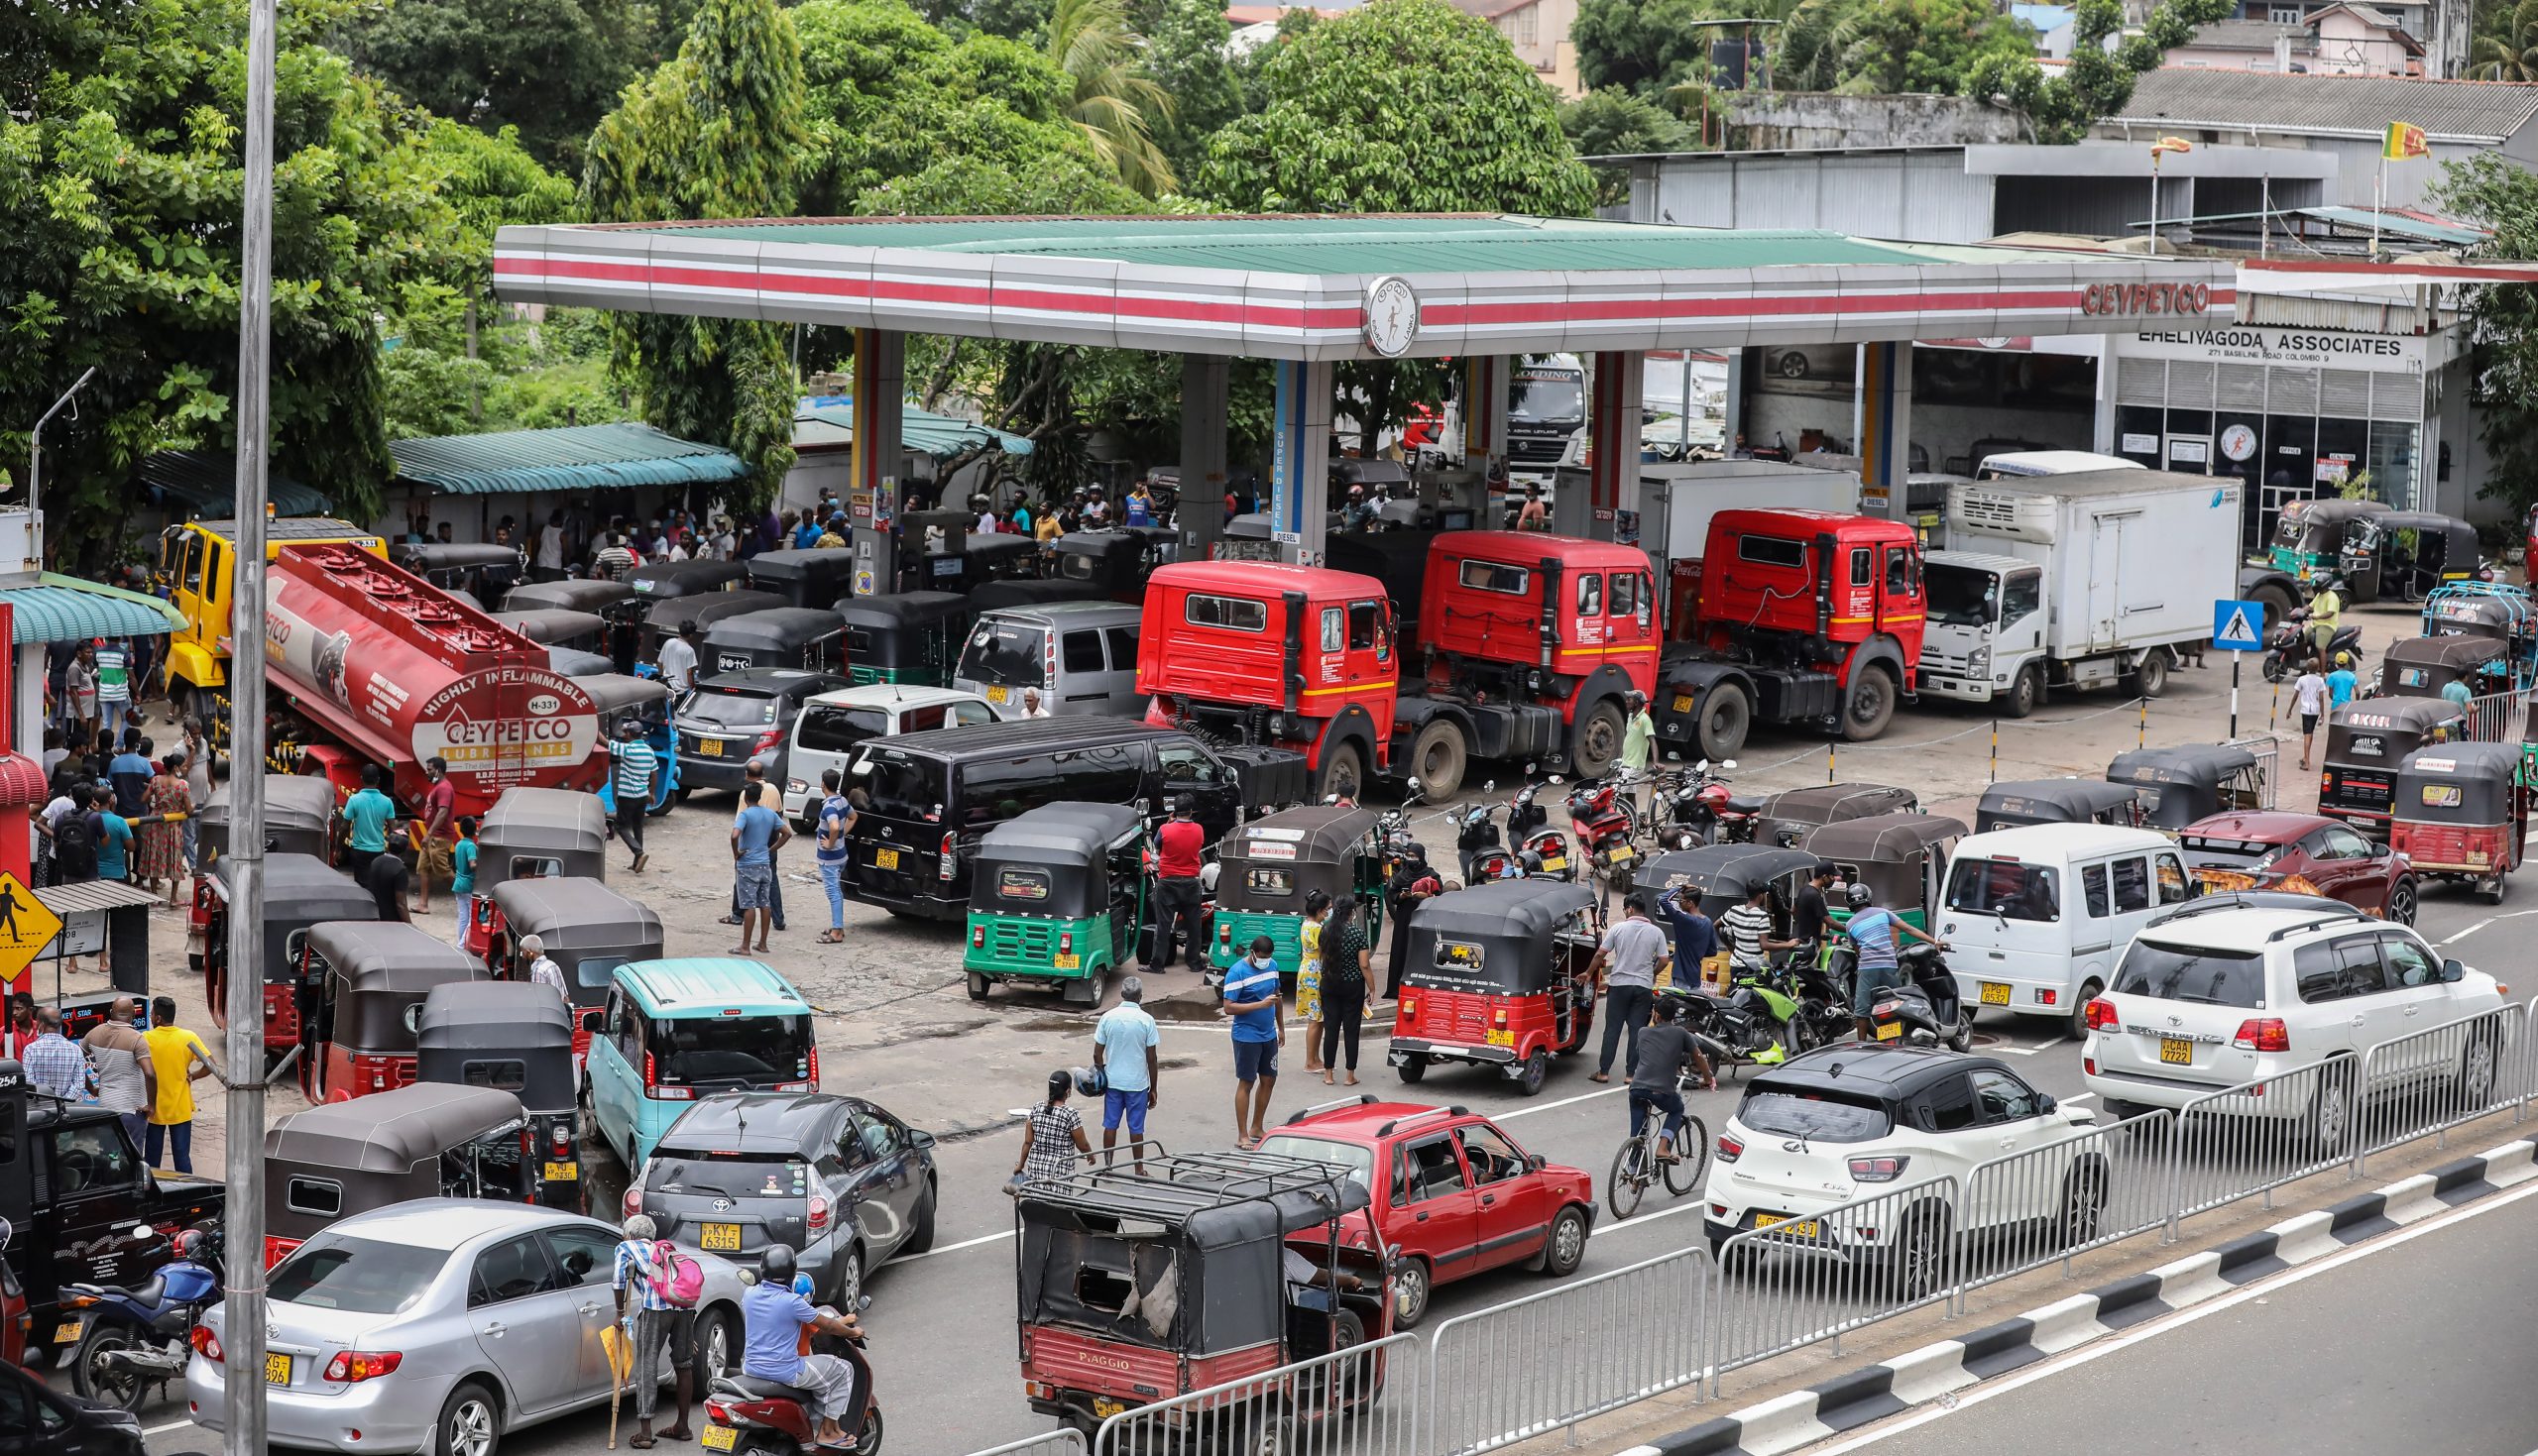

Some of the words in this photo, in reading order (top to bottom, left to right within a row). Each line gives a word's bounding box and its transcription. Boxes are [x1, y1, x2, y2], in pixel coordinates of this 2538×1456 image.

[2082, 281, 2210, 315] CEYPETCO
[2278, 334, 2401, 356] ASSOCIATES
[1520, 369, 1571, 380] OLDING
[1274, 478, 1283, 527] DIESEL
[1277, 532, 1297, 543] DIESEL
[423, 677, 477, 717] HIGHLY
[485, 669, 590, 709] INFLAMMABLE
[530, 700, 558, 710] H-331
[444, 746, 568, 760] LUBRCNTS
[1991, 984, 2002, 994] PG
[1984, 993, 2006, 1003] 8532
[2169, 1041, 2188, 1053] CAA
[2164, 1052, 2188, 1063] 7722
[713, 1224, 729, 1236] KY
[705, 1237, 736, 1249] 6315
[1079, 1351, 1129, 1370] PIAGGIO
